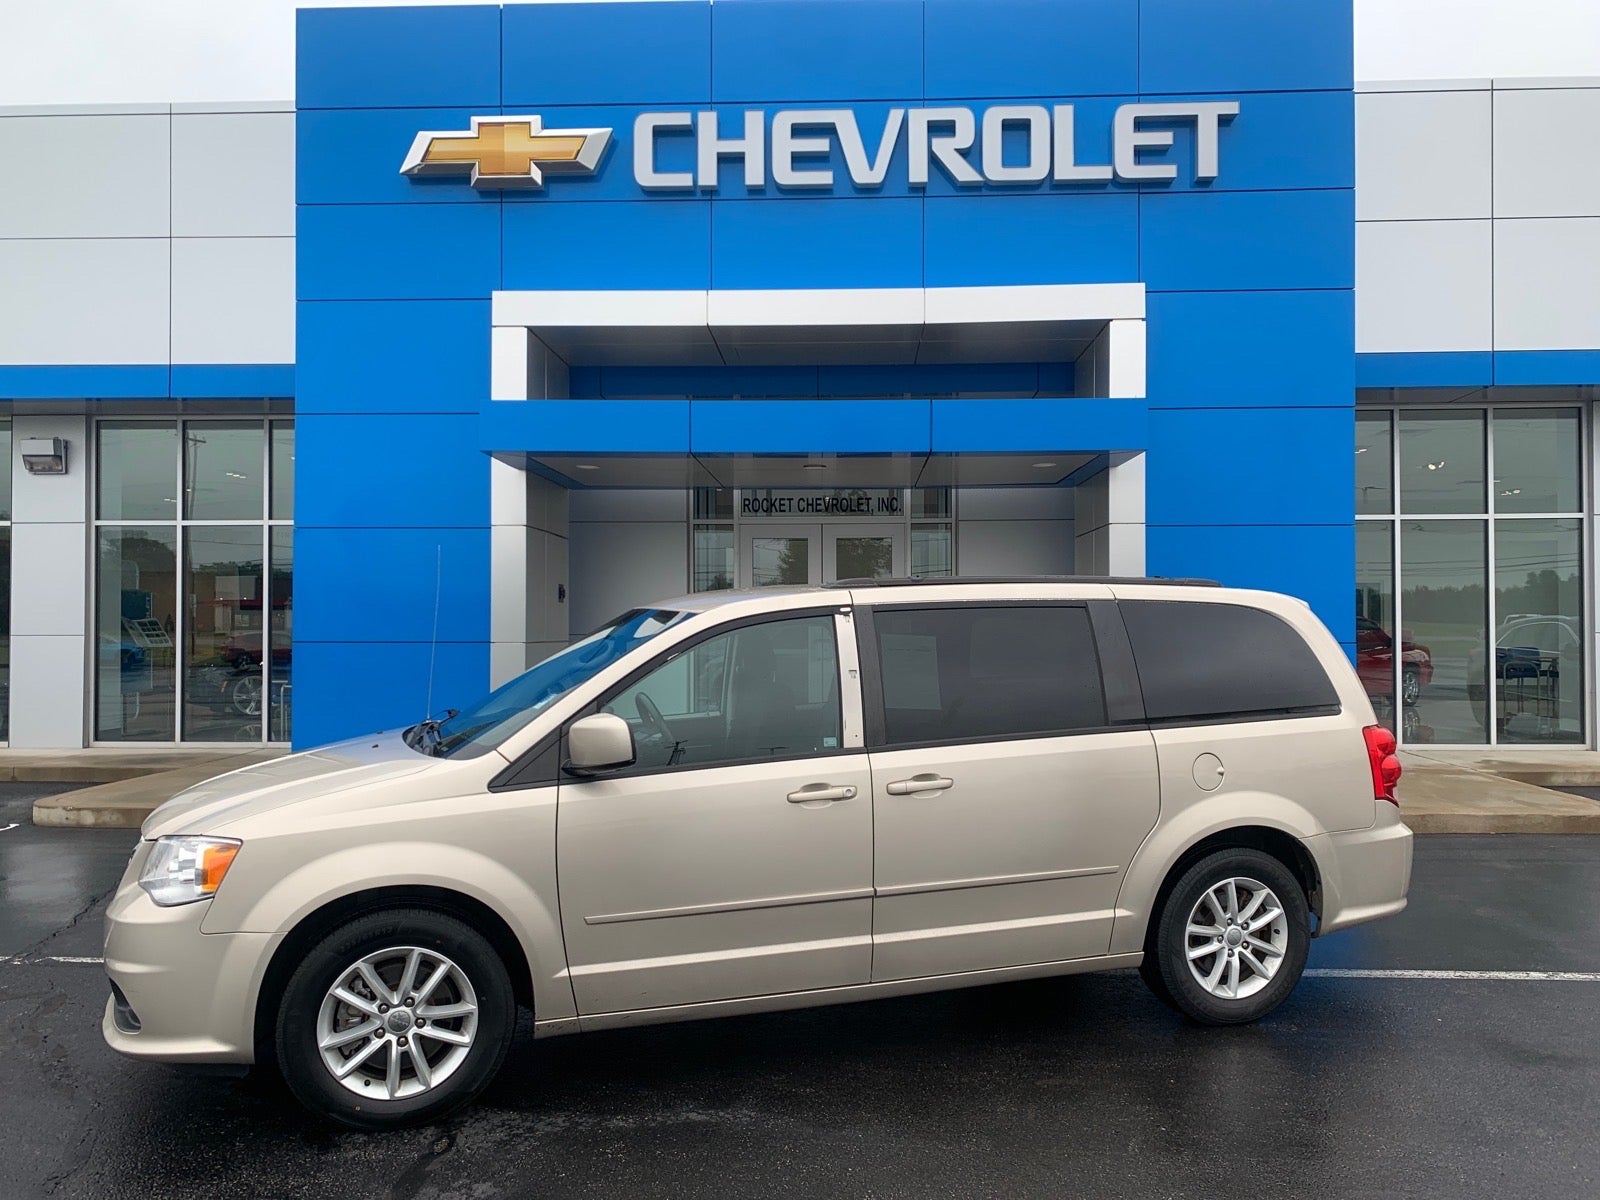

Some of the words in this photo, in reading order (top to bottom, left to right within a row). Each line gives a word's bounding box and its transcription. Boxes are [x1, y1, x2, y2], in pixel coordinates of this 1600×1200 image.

[633, 101, 1240, 190] CHEVROLET
[743, 497, 793, 513] ROCKET
[797, 497, 874, 515] CHEVROLET,
[877, 497, 902, 512] INC.
